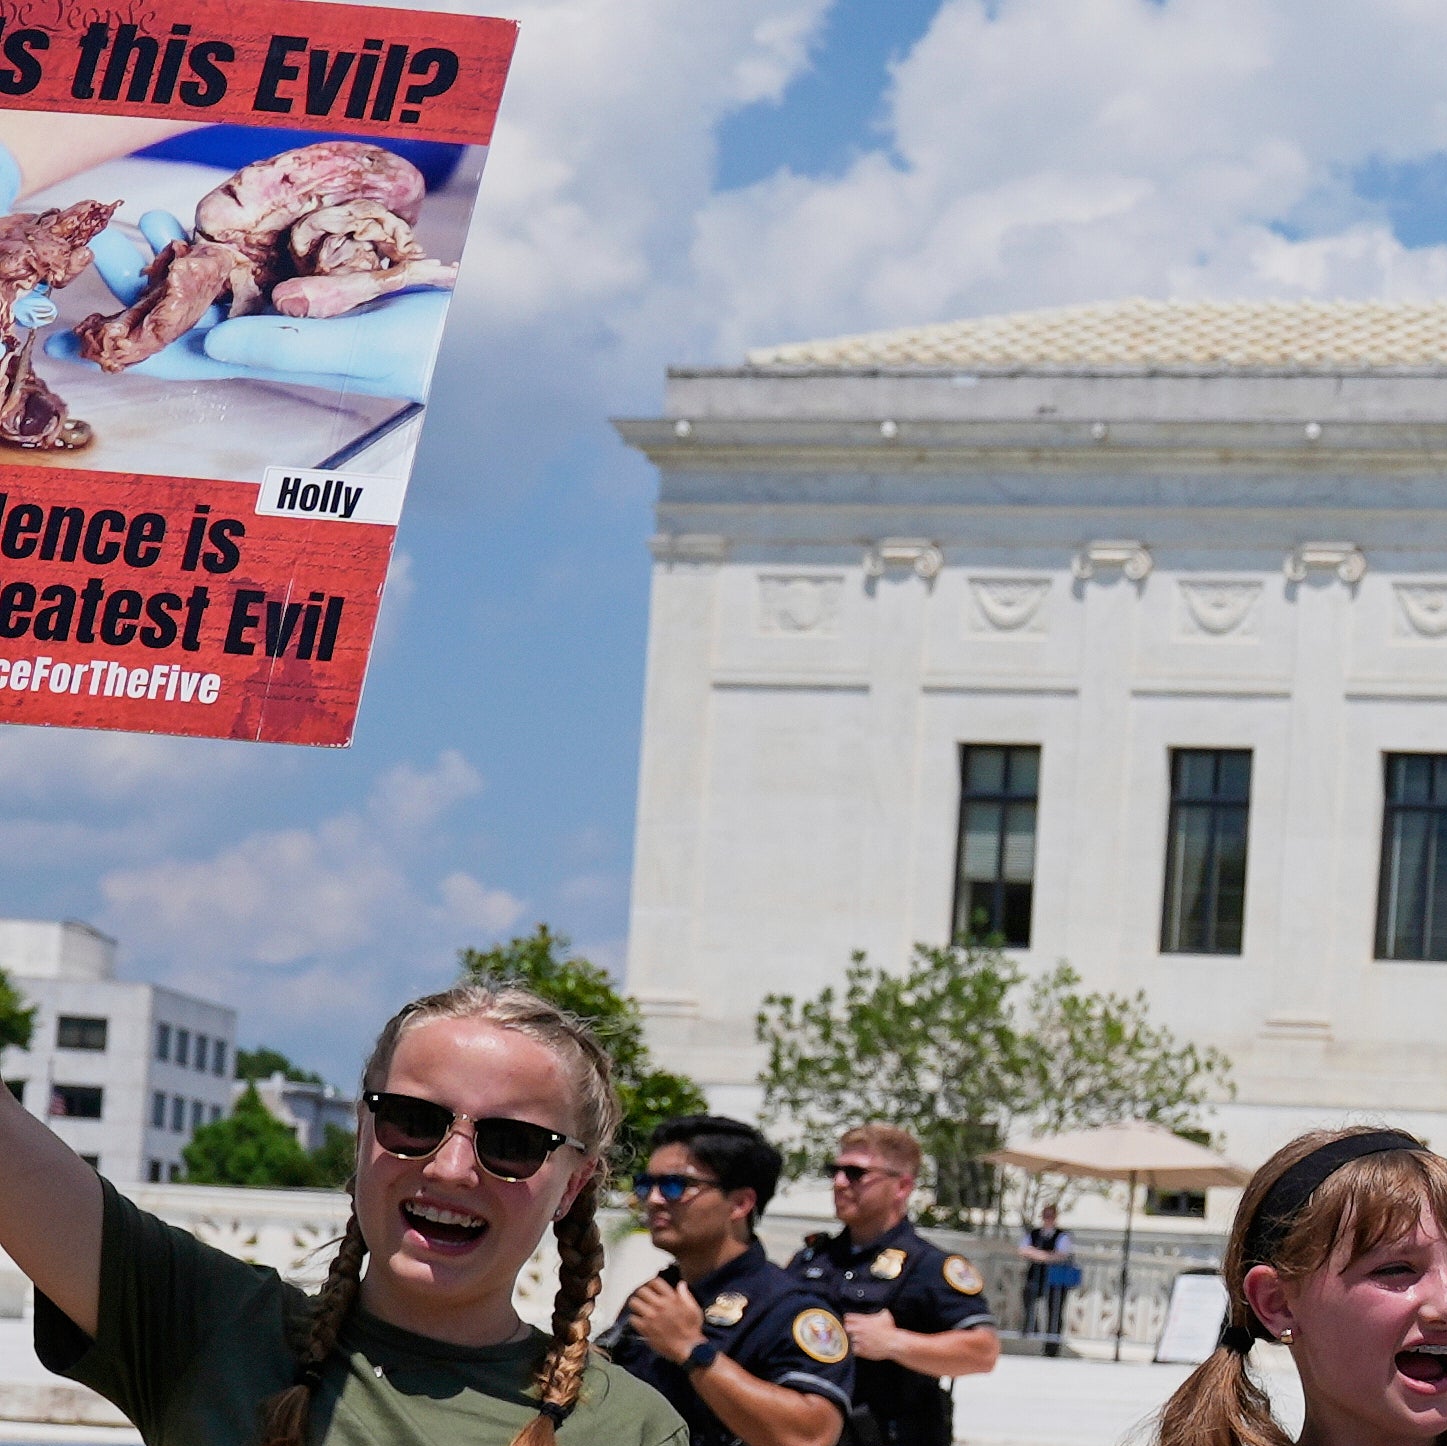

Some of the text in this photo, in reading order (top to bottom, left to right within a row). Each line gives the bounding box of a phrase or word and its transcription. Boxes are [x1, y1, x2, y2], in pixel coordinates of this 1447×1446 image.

[0, 16, 459, 124] s this Evil?
[0, 493, 246, 574] ence is
[276, 477, 363, 519] Holly
[0, 578, 346, 662] eatest Evil
